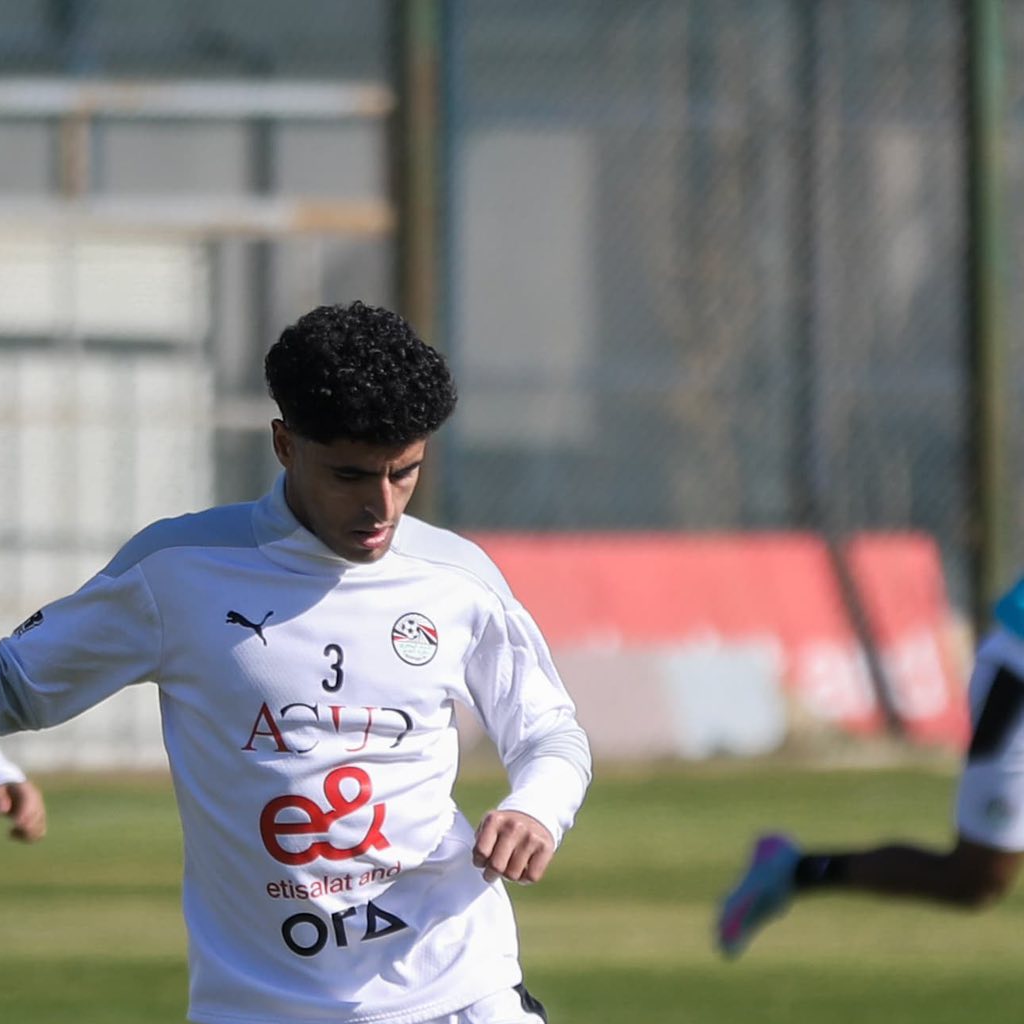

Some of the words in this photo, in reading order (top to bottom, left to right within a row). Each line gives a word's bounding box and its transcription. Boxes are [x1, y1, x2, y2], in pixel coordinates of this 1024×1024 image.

[321, 643, 345, 693] 3
[266, 873, 353, 900] etisalat
[358, 861, 402, 888] and
